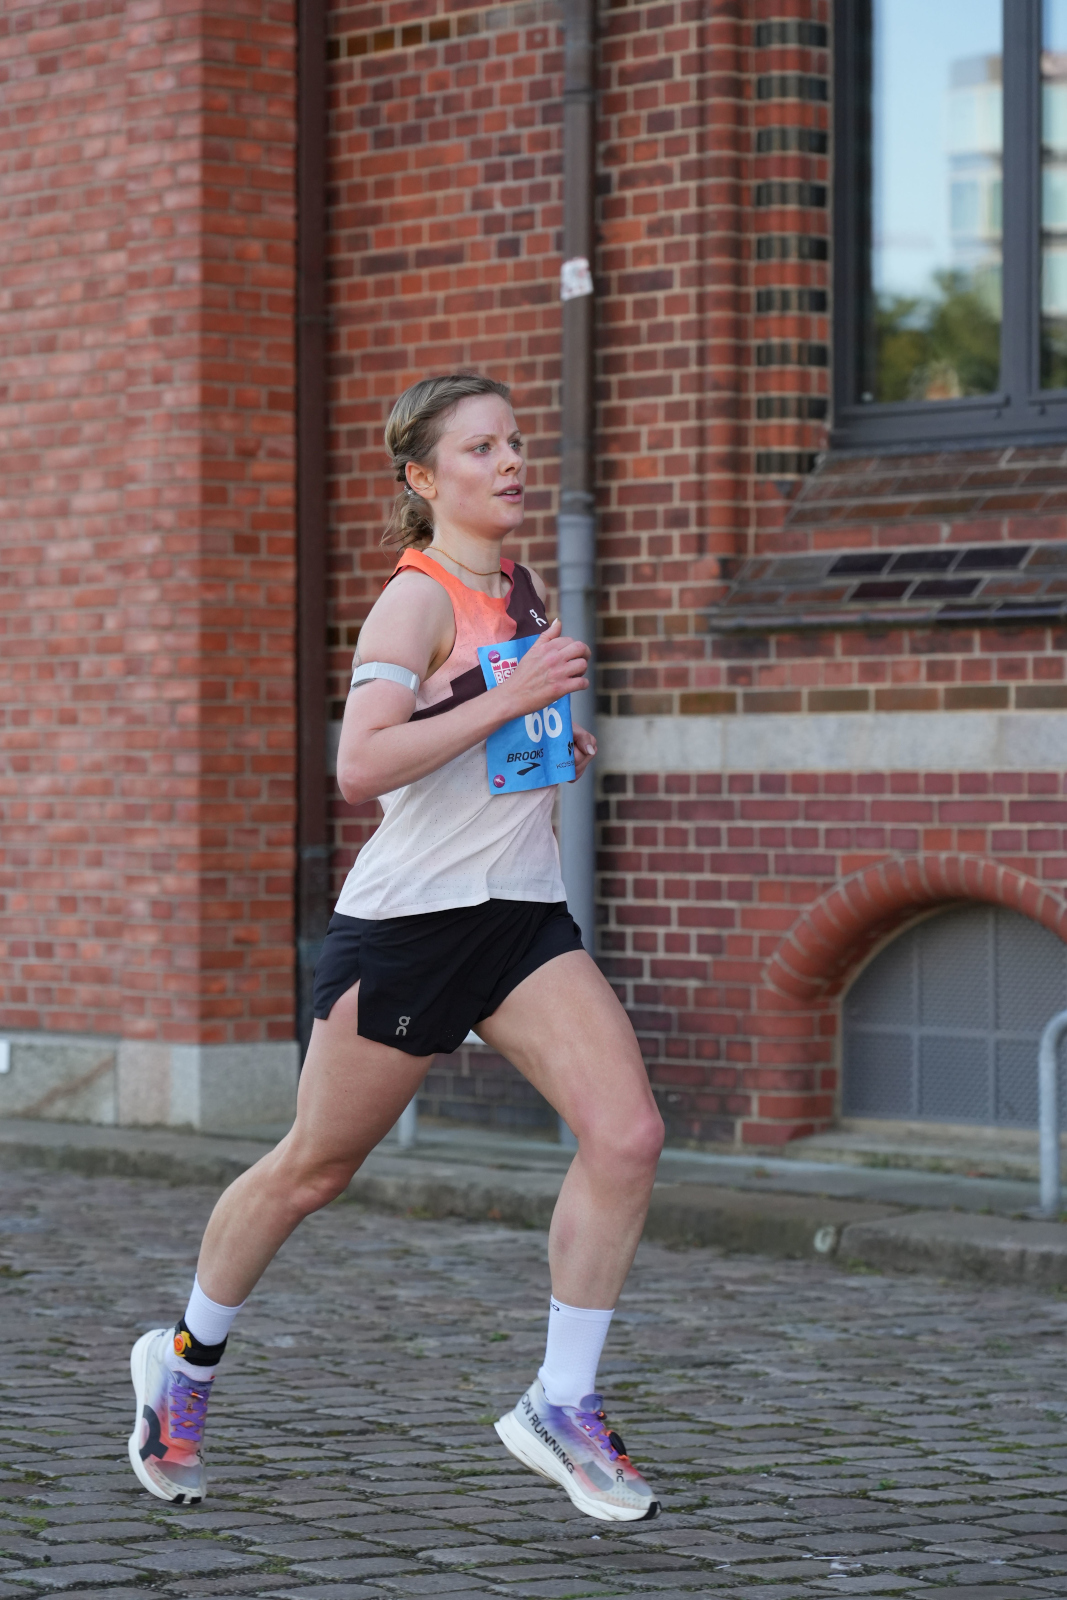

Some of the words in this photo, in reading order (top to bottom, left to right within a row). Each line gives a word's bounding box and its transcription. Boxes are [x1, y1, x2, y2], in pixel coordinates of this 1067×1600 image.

[506, 748, 544, 763] BROOKS
[520, 1393, 533, 1415] ON
[528, 1412, 575, 1474] RUNNING
